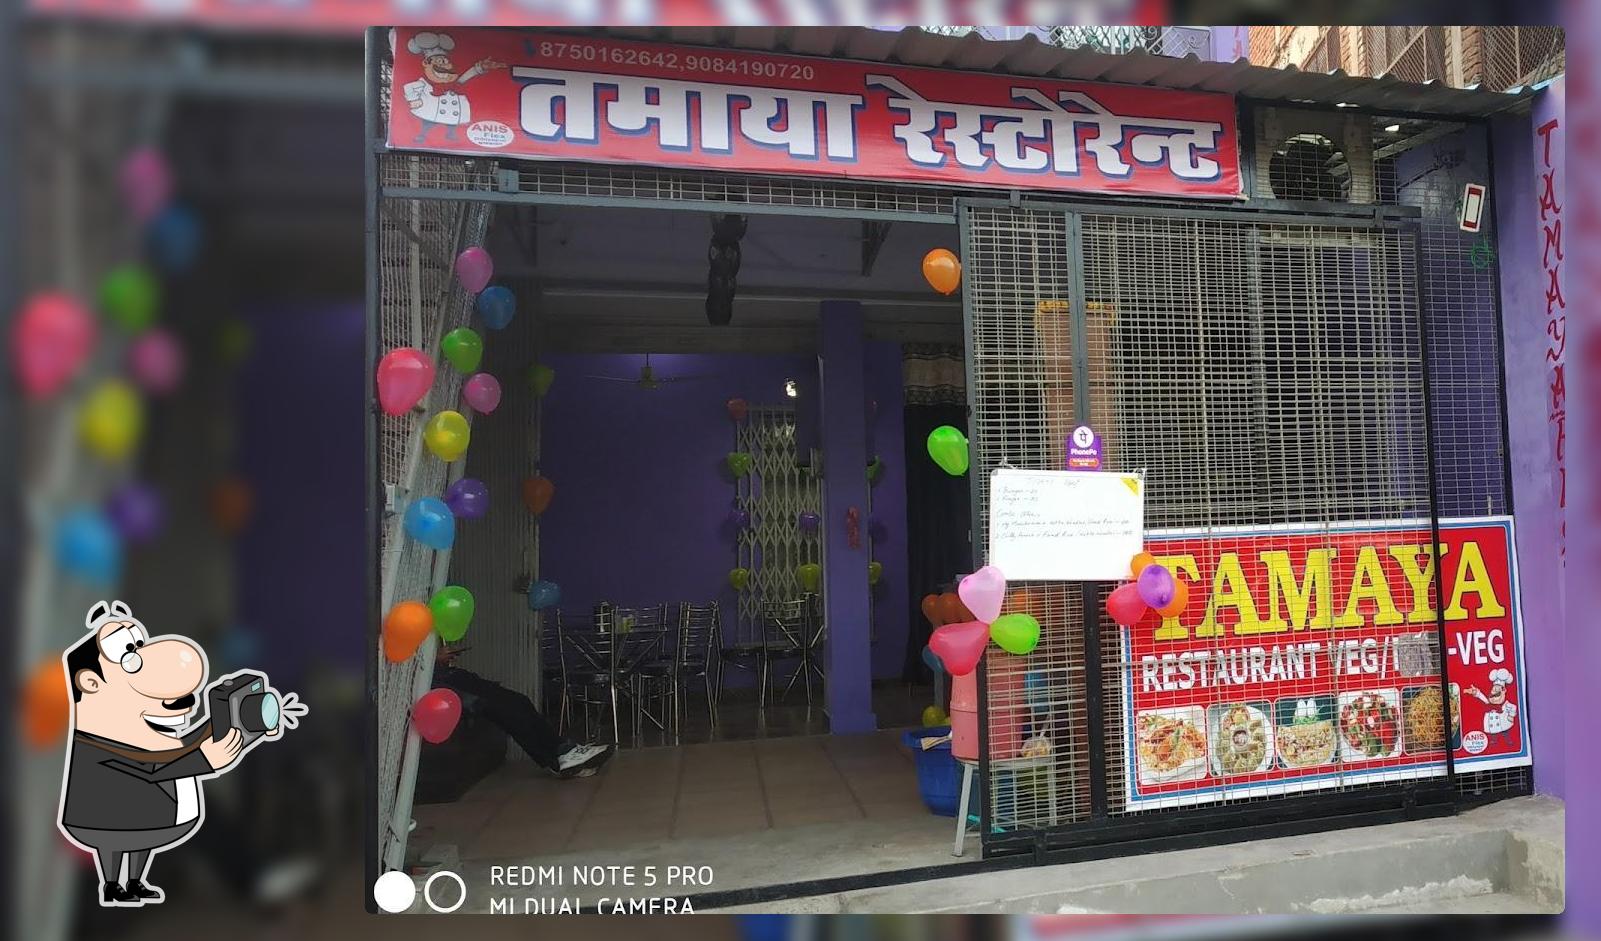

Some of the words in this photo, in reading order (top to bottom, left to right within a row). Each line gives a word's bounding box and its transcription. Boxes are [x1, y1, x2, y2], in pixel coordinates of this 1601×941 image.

[540, 41, 814, 81] 8750162642,9084190720
[471, 124, 508, 133] ANIS
[512, 66, 864, 161] तमाया
[865, 74, 1222, 181] रेस्टोरेन्ट
[1142, 642, 1321, 693] RESTAURANT
